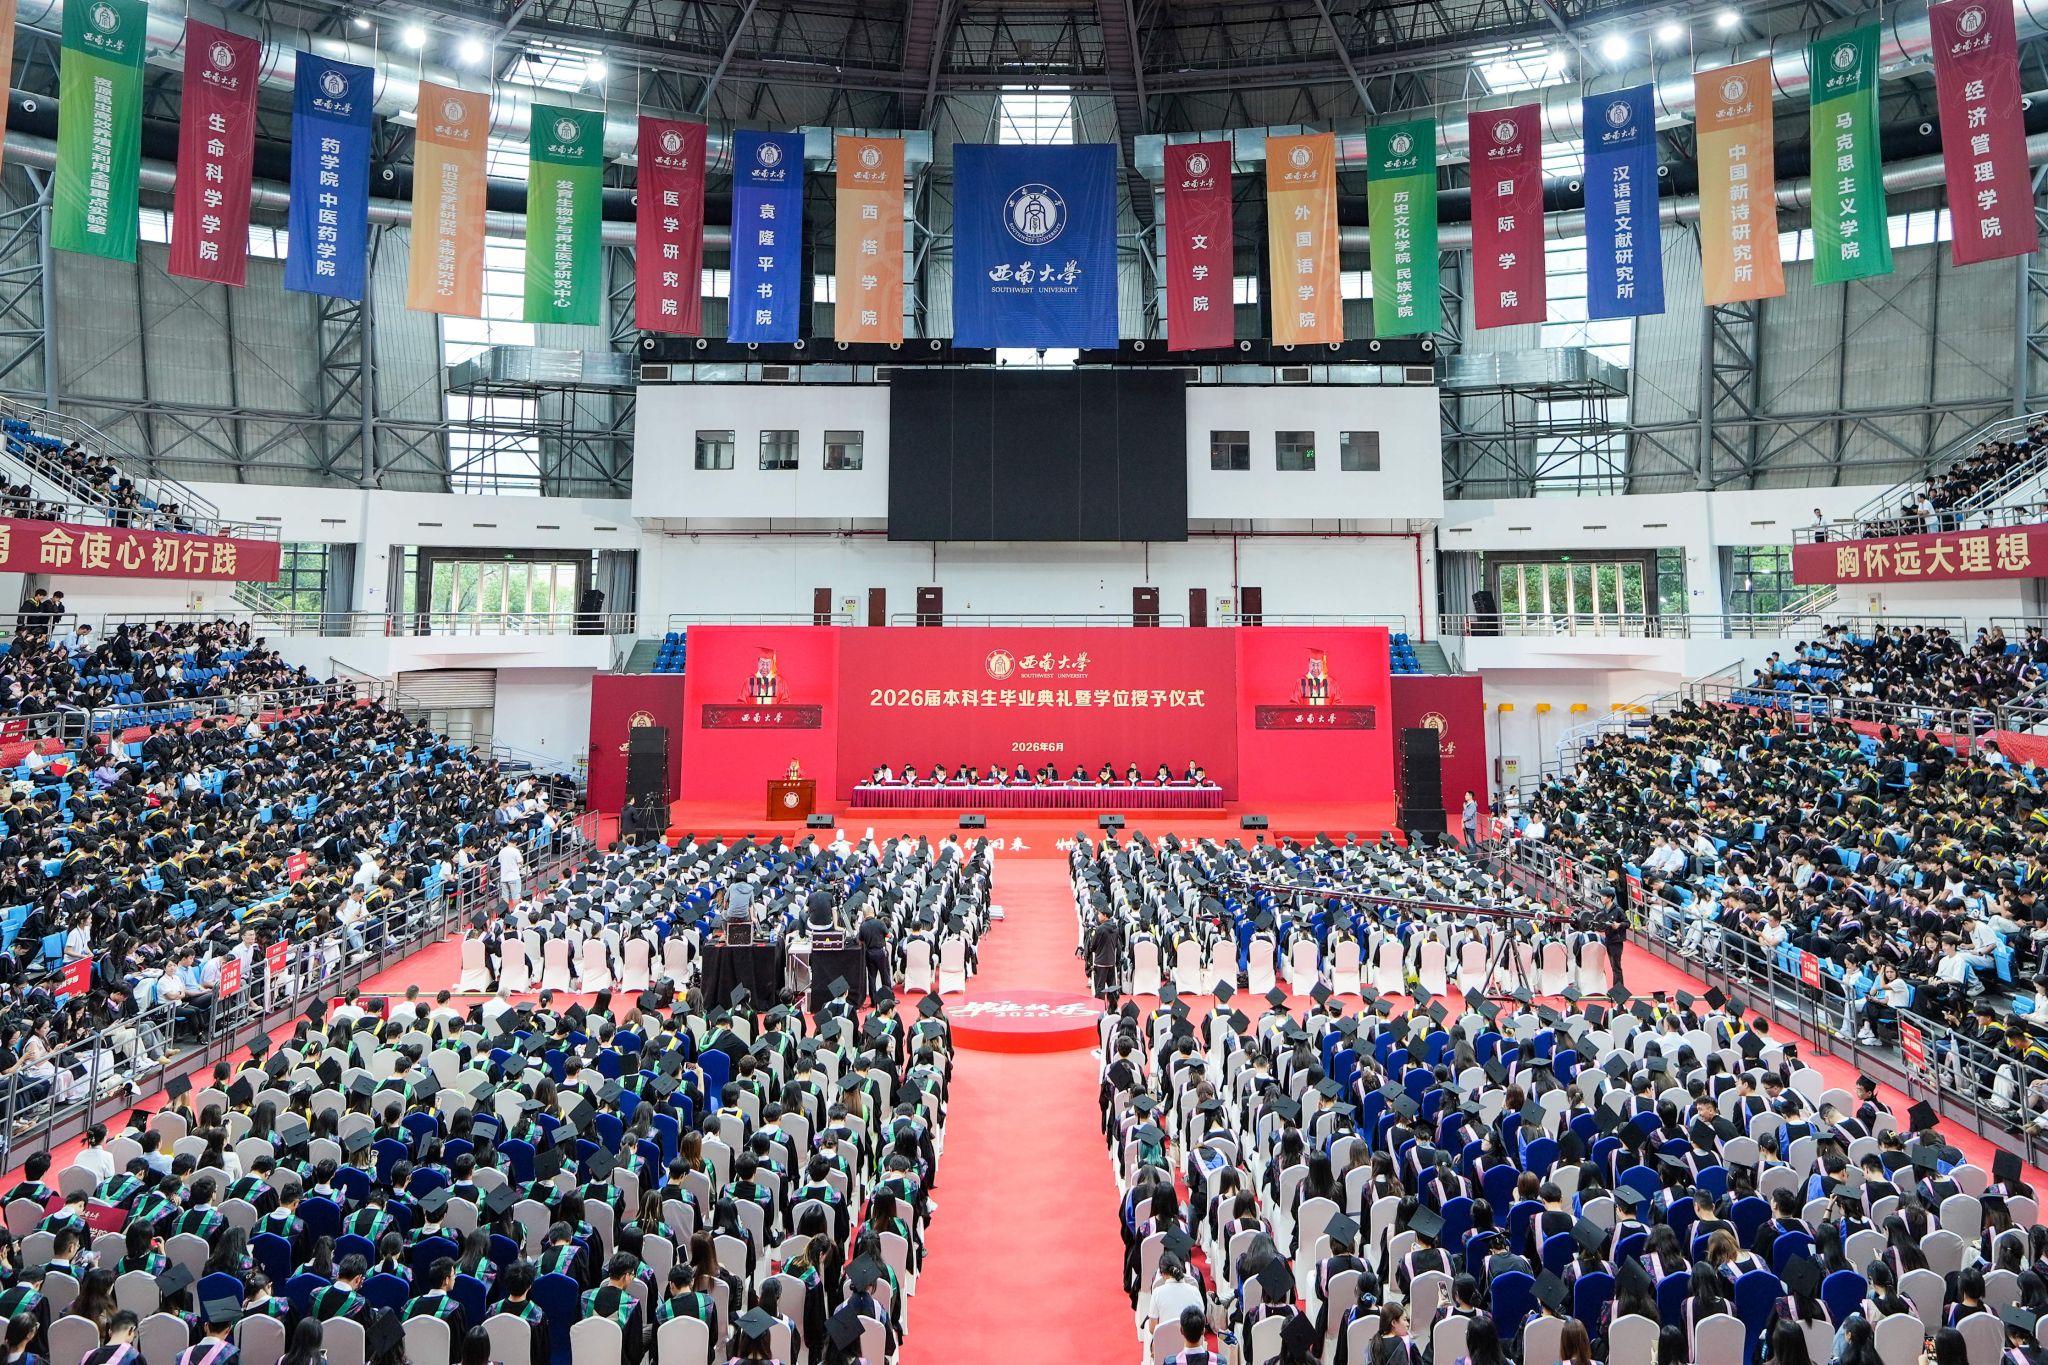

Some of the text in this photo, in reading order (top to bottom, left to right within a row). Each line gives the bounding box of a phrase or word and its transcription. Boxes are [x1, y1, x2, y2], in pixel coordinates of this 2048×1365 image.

[200, 113, 225, 261] 生命科学学院
[320, 138, 340, 187] 药学院
[1729, 145, 1752, 282] 中国新诗研究所
[1836, 112, 1859, 260] 马克思主义学院
[1965, 80, 2001, 239] 经济管理学院
[317, 193, 337, 276] 中医药学院
[438, 164, 457, 295] 前沿交叉学科研究院 生物学研究中心
[554, 180, 574, 307] 发育生物学与再生医学研究中心
[662, 191, 679, 315] 医学研究院
[756, 204, 775, 325] 袁隆平书院
[860, 205, 877, 325] 西塔学院
[1192, 235, 1208, 311] 文学院
[1295, 206, 1315, 327] 外国语学院
[1394, 192, 1410, 264] 历史文化学院
[1498, 180, 1517, 308] 国际学院
[1613, 166, 1634, 299] 汉语言文献研究所
[1396, 269, 1413, 317] 民族学院
[1836, 533, 2031, 578] 胸怀远大理想
[870, 689, 1205, 707] 2026届本科生毕业典礼暨学位授予仪式
[1011, 742, 1063, 752] 2026年6月
